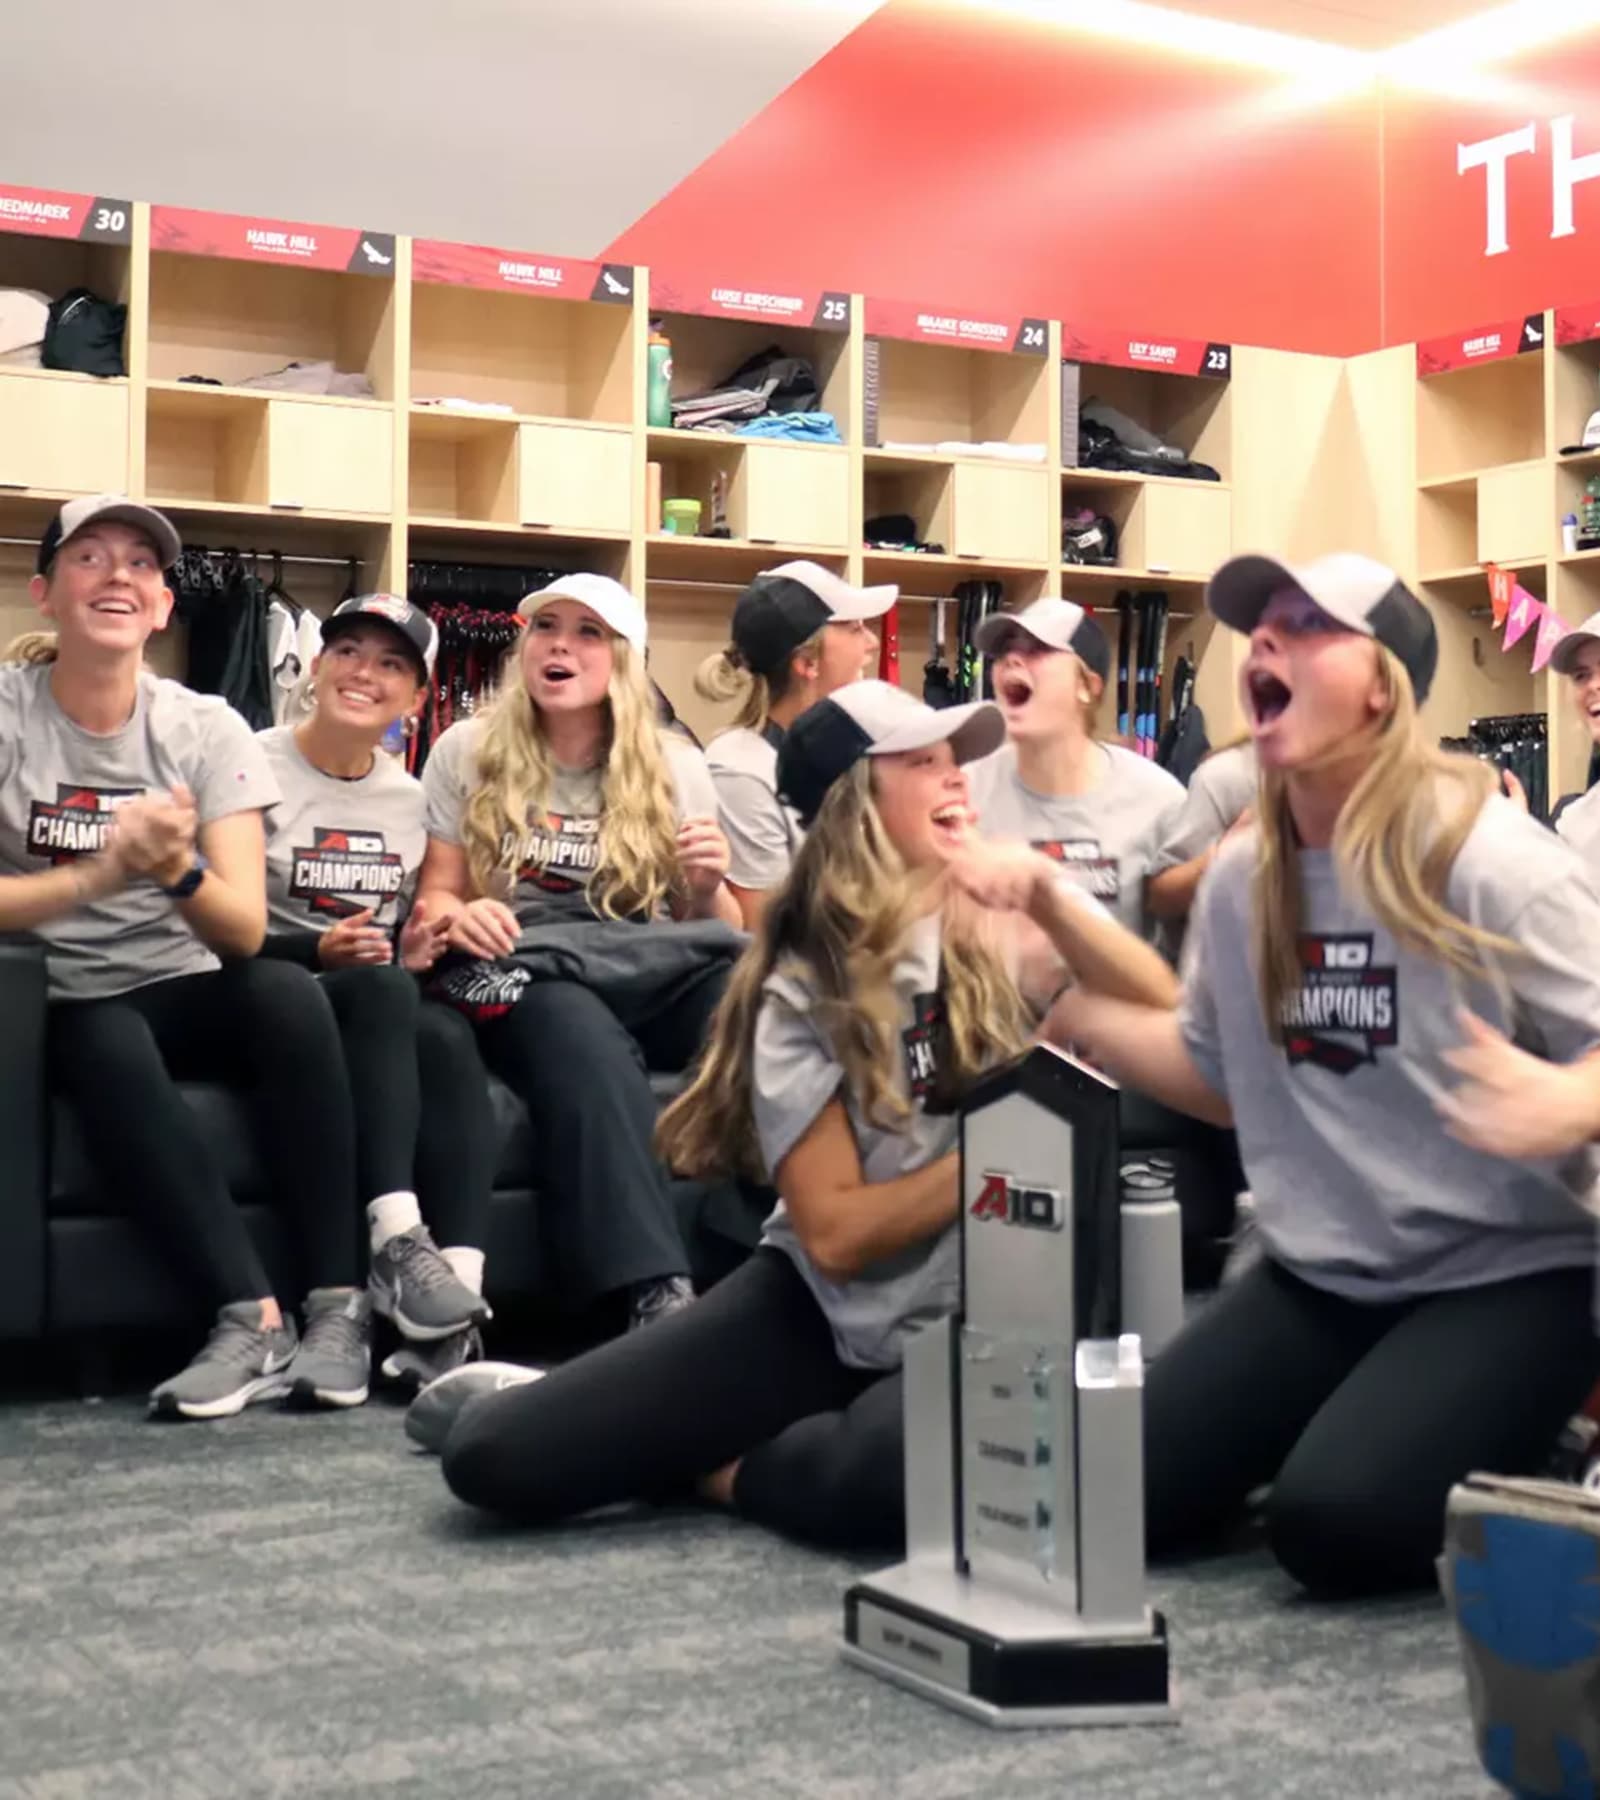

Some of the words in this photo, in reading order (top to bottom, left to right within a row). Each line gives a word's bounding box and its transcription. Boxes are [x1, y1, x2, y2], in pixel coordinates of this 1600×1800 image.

[94, 208, 126, 232] 30
[246, 229, 288, 248] HAWK
[289, 234, 318, 252] HILL
[499, 261, 536, 278] HAWK
[537, 266, 563, 282] HILL
[822, 300, 846, 321] 25
[1022, 326, 1044, 347] 24
[1207, 350, 1228, 370] 23
[33, 817, 113, 851] CHAMP
[320, 831, 383, 852] A10
[294, 860, 402, 892] CHAMPIONS
[970, 1172, 1063, 1231] A10
